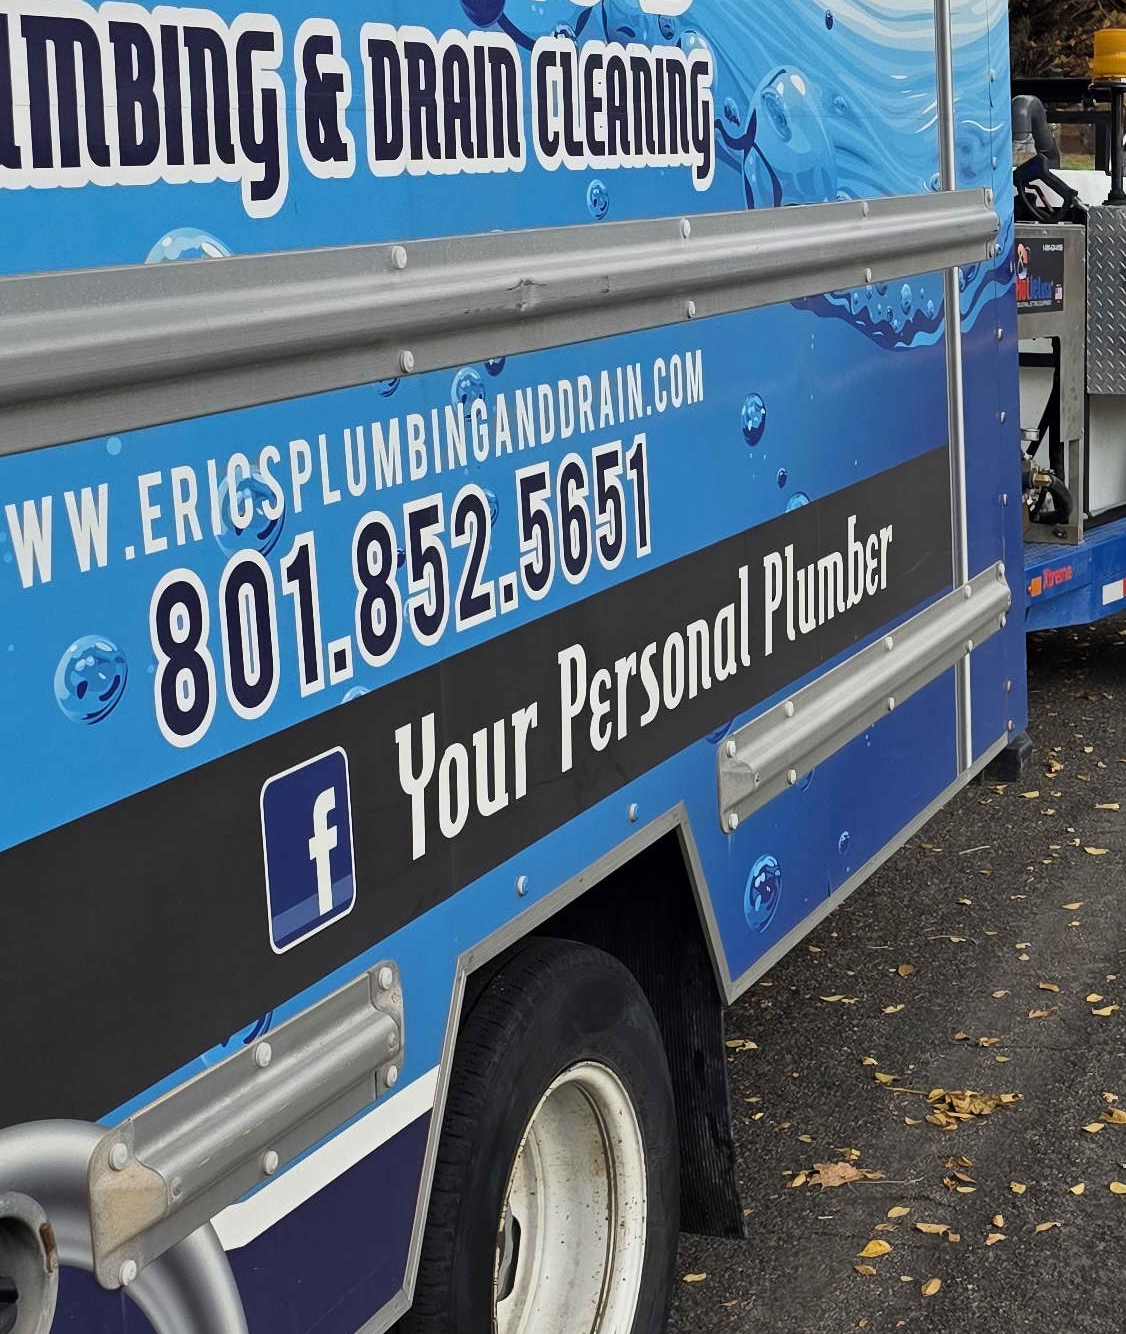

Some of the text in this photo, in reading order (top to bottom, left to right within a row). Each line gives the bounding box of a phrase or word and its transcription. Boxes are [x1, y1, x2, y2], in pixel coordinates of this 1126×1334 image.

[303, 34, 348, 162] &
[366, 38, 521, 161] DRAIN
[537, 50, 710, 180] CLEANING
[151, 435, 651, 745] 801.852.5651
[394, 514, 894, 861] Your Personal Plumber
